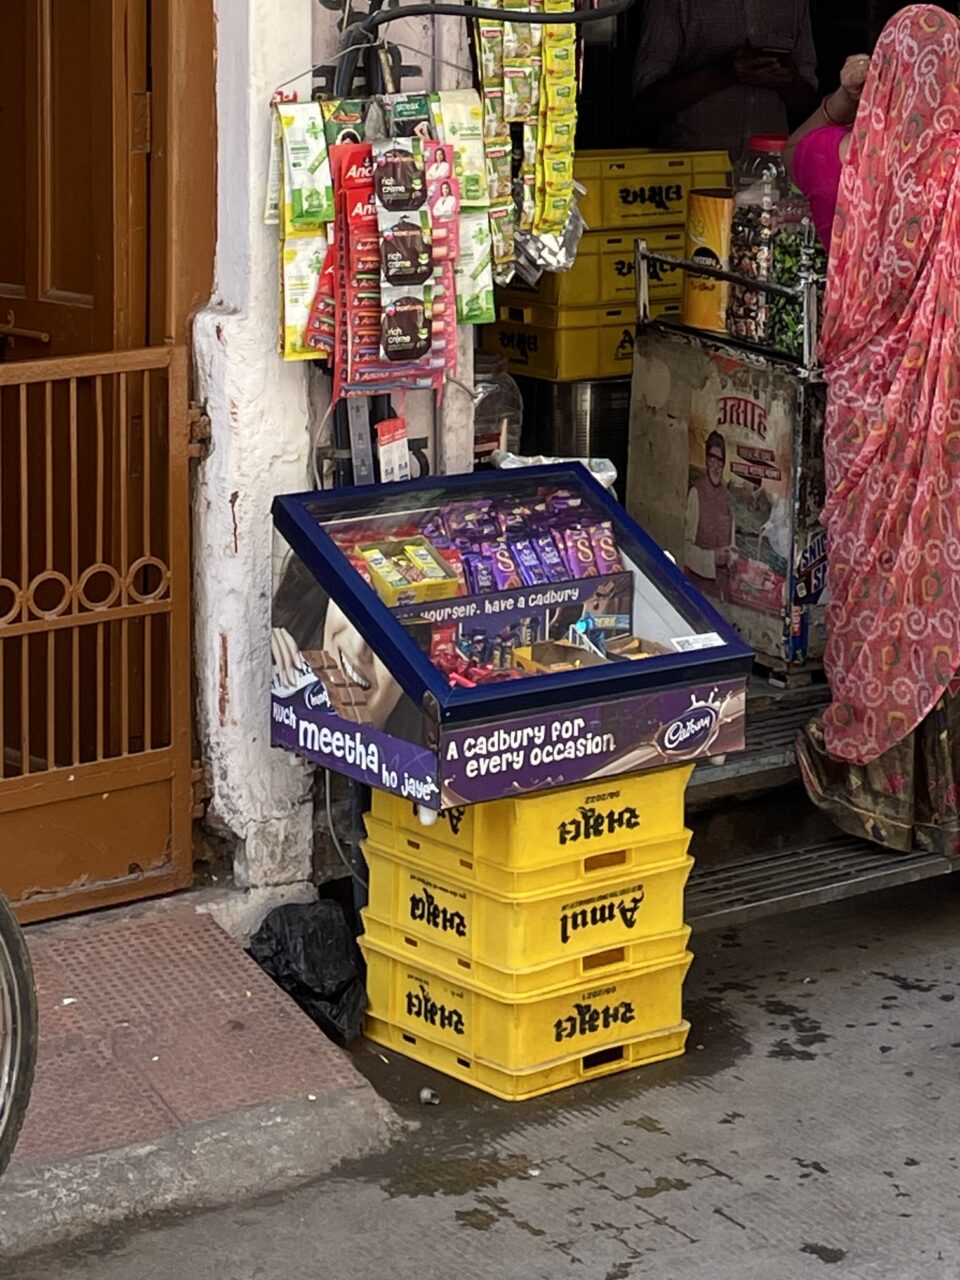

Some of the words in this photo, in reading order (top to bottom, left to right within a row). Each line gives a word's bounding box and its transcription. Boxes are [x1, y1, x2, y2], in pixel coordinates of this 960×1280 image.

[485, 597, 514, 615] have
[517, 599, 526, 609] a
[446, 741, 459, 761] A
[552, 718, 585, 741] for
[664, 713, 711, 749] Cadbury
[299, 718, 378, 774] meetha
[382, 763, 398, 788] ho
[466, 747, 525, 778] every
[559, 891, 646, 944] Amul
